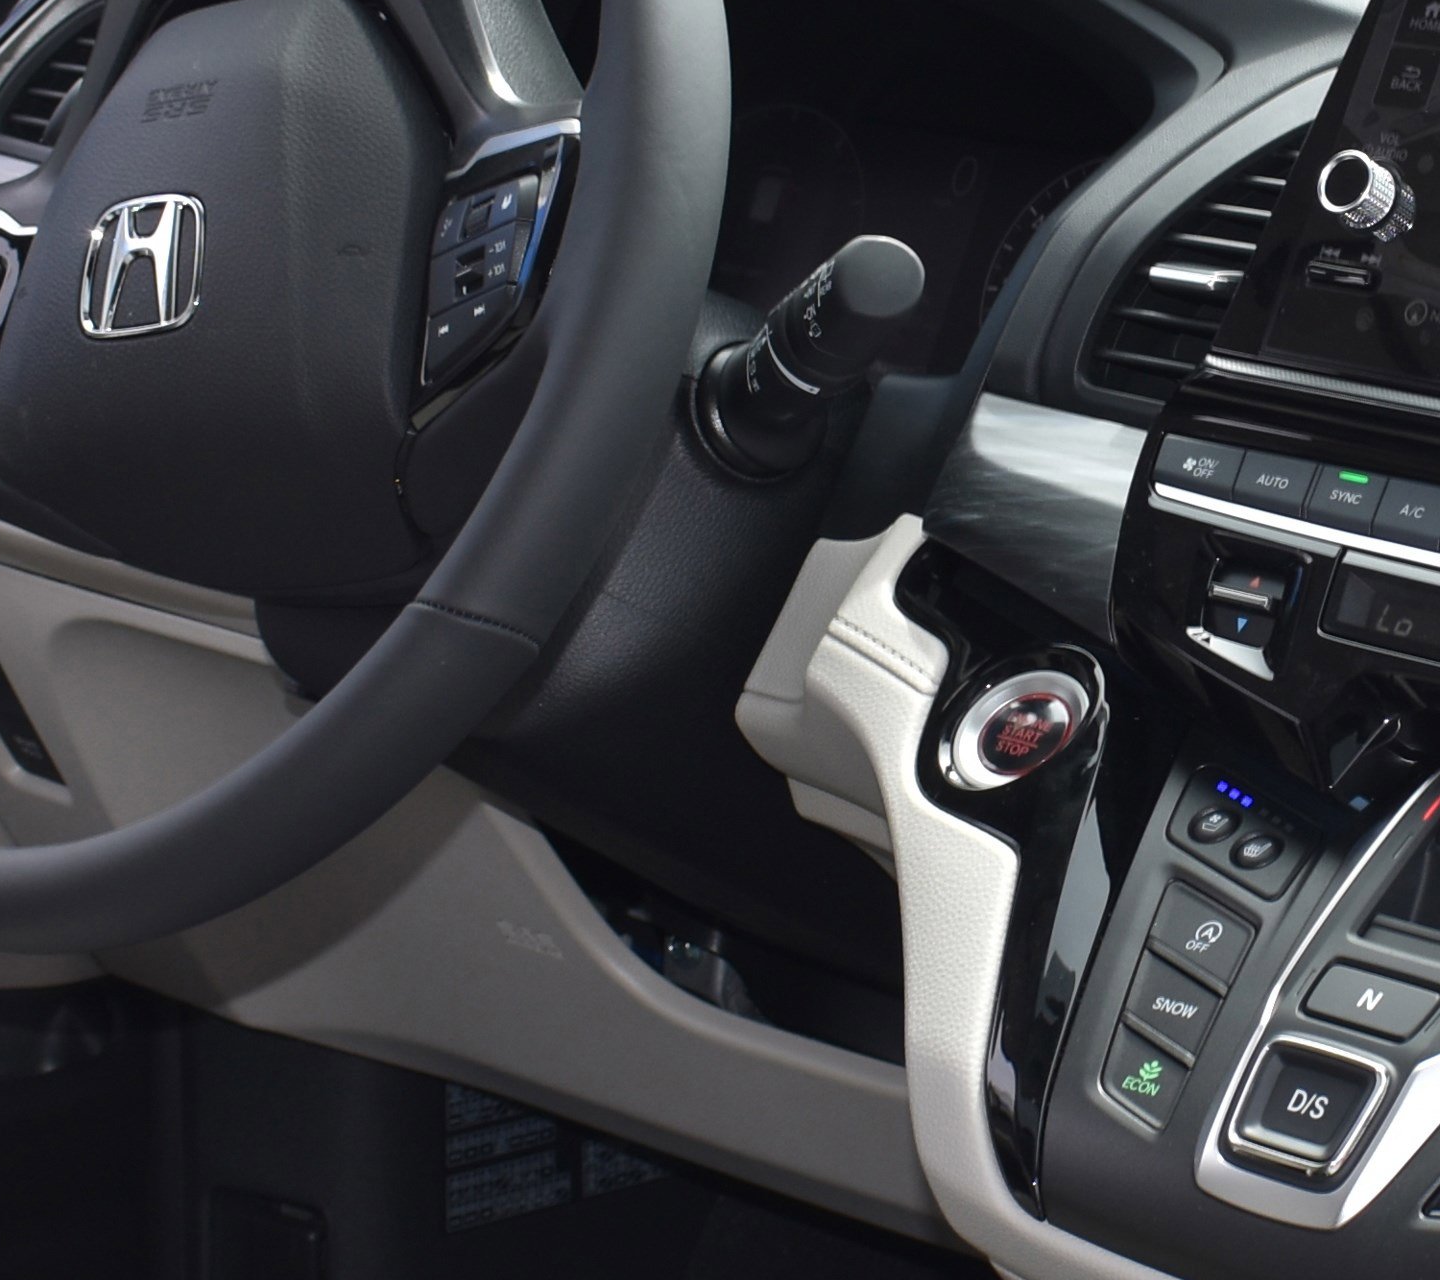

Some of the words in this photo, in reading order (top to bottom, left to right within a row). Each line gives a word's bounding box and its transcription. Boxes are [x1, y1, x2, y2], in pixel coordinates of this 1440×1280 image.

[1391, 75, 1422, 93] BACK
[1380, 131, 1400, 145] VOL
[1197, 457, 1219, 469] ON/
[1192, 468, 1215, 480] OFF
[1256, 473, 1290, 489] AUTO
[1329, 489, 1362, 505] SYNC
[1399, 503, 1426, 519] A/C
[1001, 722, 1045, 744] START
[995, 739, 1031, 757] STOP
[1184, 939, 1211, 954] OFF
[1152, 995, 1199, 1020] SNOW
[1356, 987, 1384, 1011] N
[1121, 1075, 1161, 1097] ECON
[1286, 1088, 1329, 1120] D/S
